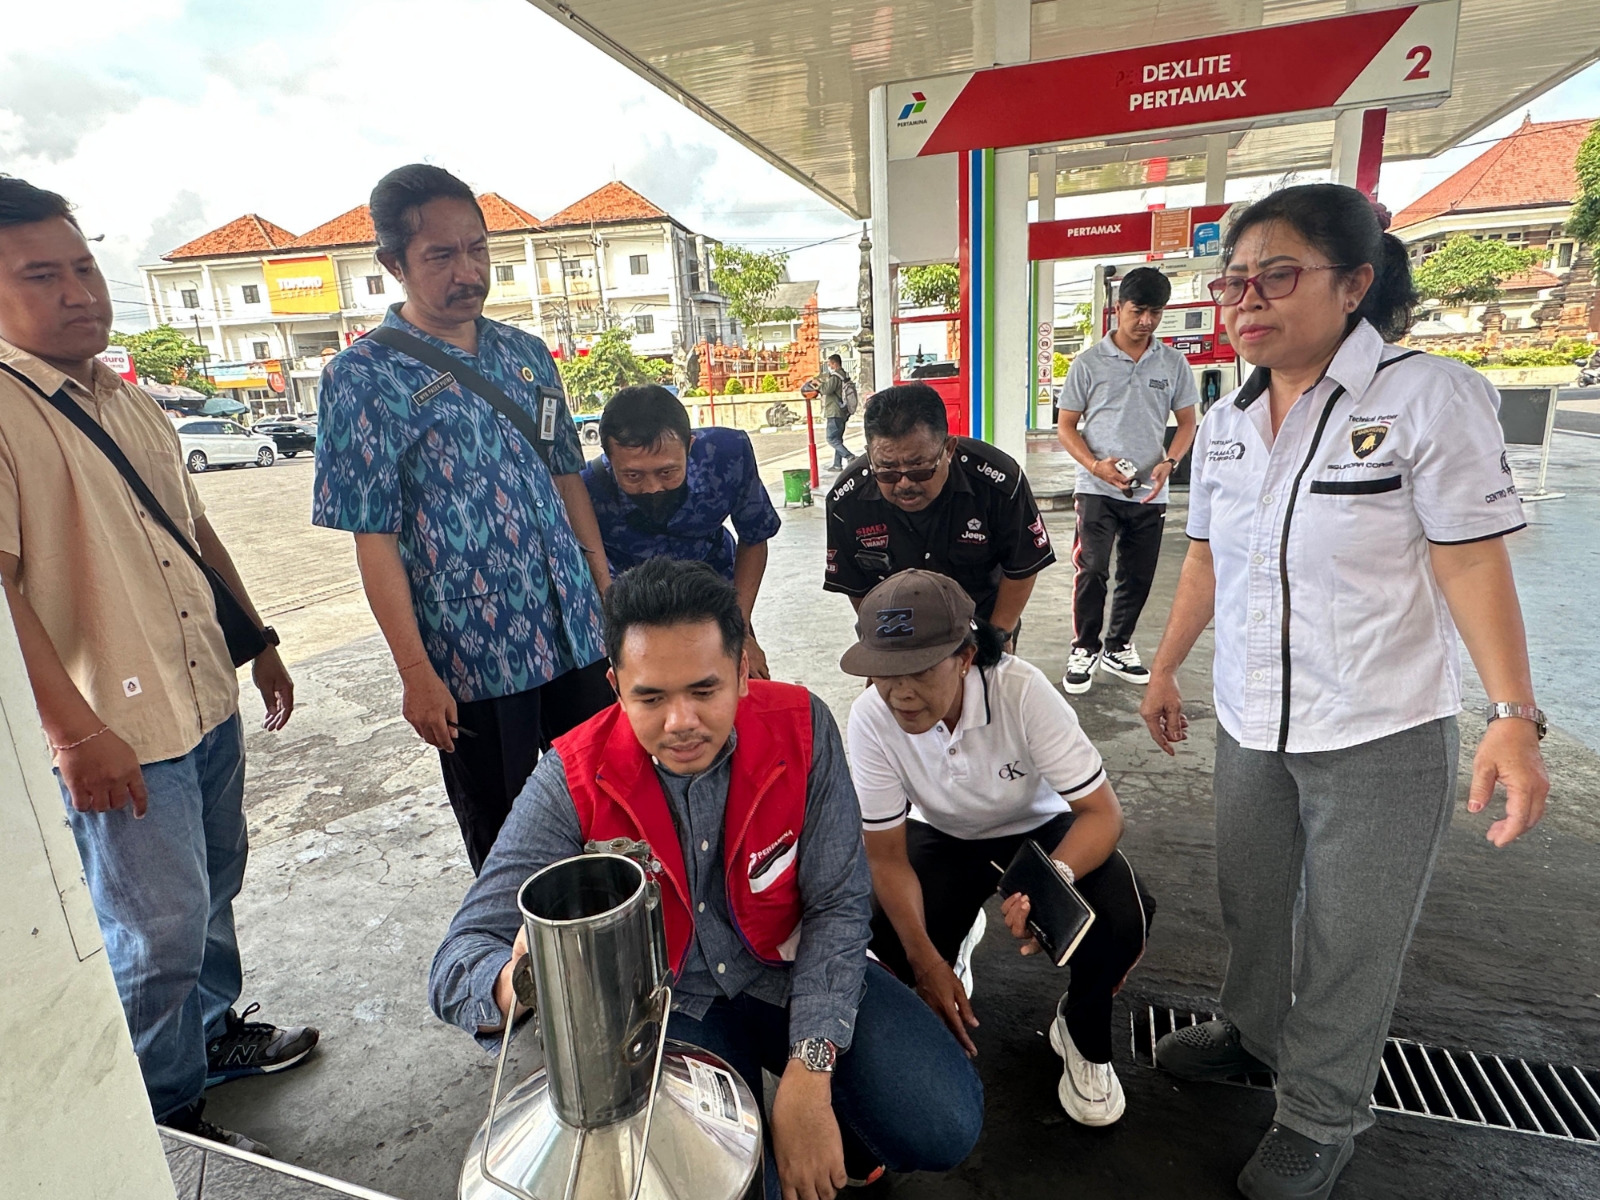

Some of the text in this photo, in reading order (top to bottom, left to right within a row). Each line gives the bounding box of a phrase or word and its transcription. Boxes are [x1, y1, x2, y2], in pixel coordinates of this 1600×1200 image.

[1142, 54, 1231, 83] DEXLITE
[1403, 45, 1432, 81] 2
[1129, 79, 1247, 111] PERTAMAX
[897, 119, 927, 128] PERTAMINA
[1067, 224, 1121, 237] PERTAMAX
[1348, 414, 1376, 422] Technical
[1207, 448, 1236, 456] TAMAX
[976, 462, 1006, 483] Jeep
[833, 477, 855, 501] Jeep
[1485, 489, 1506, 503] CENTRO
[961, 531, 986, 542] Jeep
[757, 829, 794, 860] PERTAMINA
